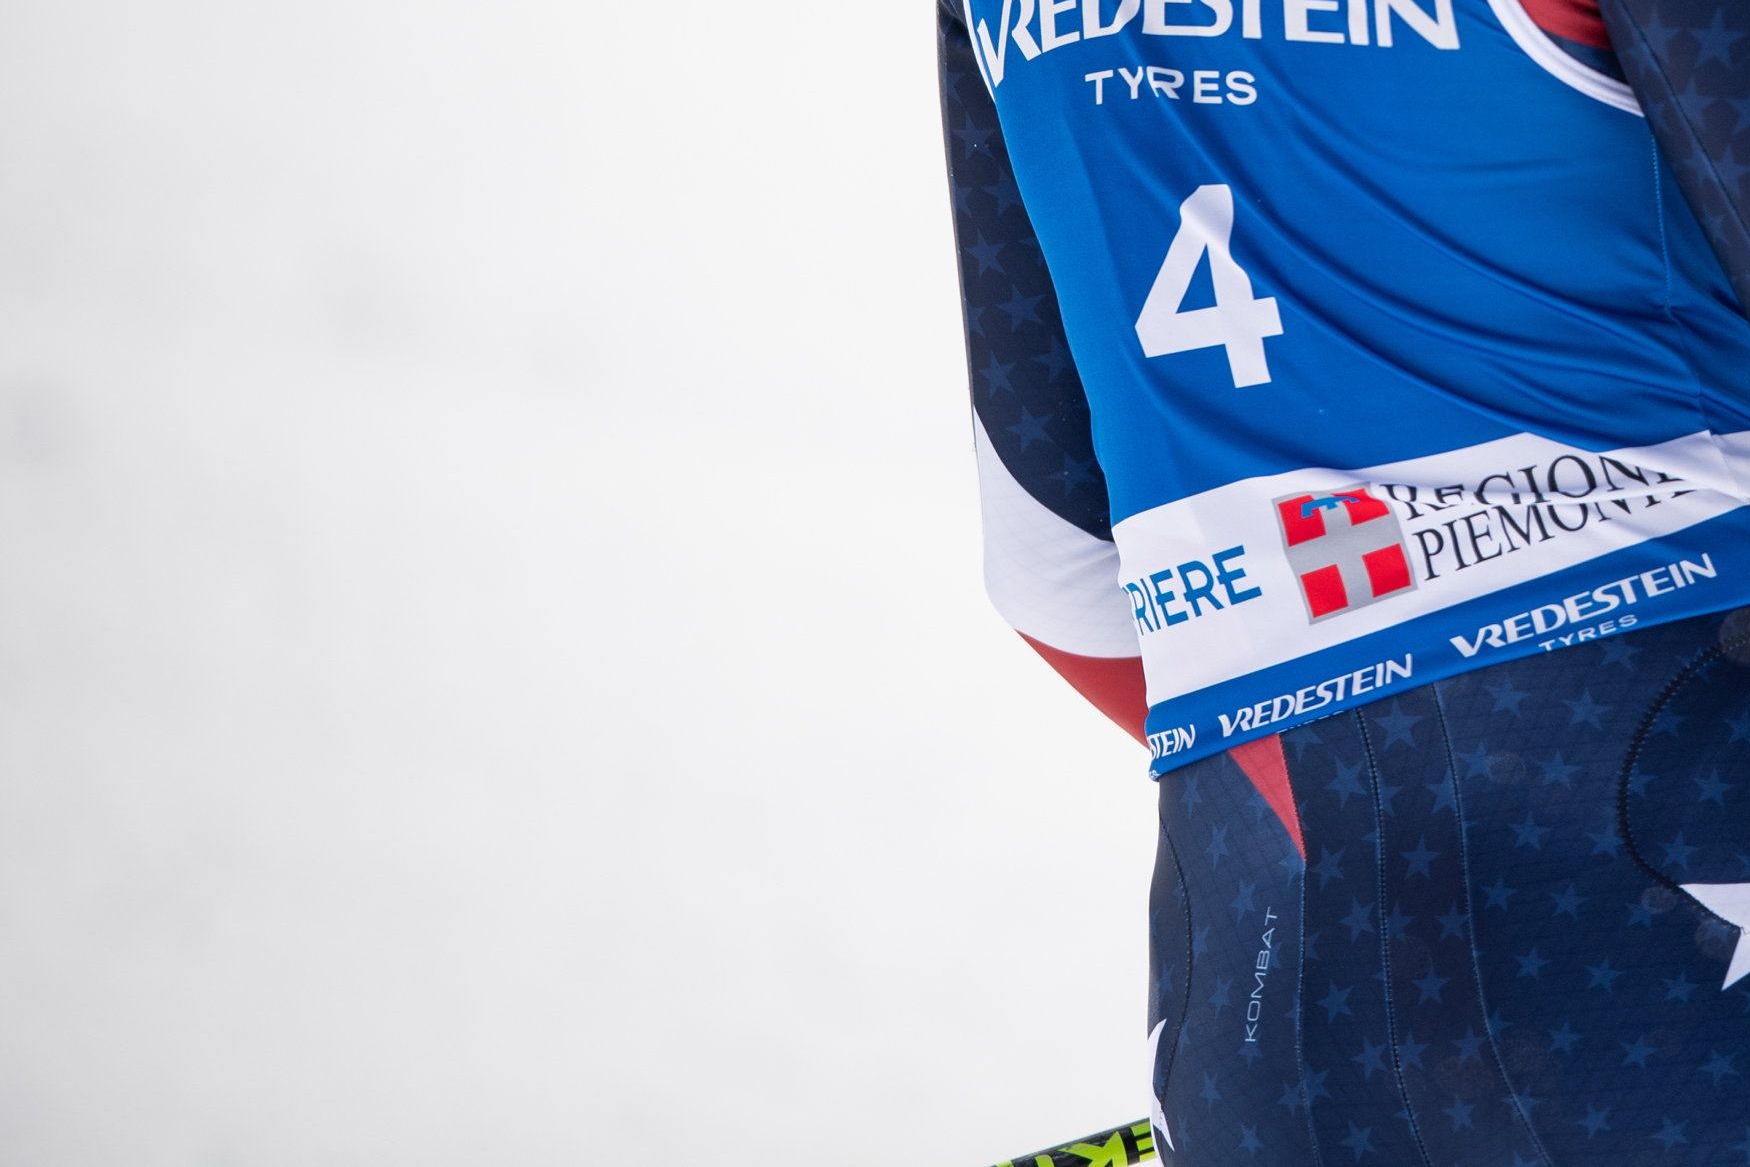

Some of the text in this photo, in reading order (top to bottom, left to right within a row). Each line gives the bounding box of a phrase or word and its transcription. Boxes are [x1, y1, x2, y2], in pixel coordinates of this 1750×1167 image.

[1085, 65, 1258, 106] TYRES
[1135, 183, 1284, 389] 4
[1122, 544, 1262, 636] RIERE
[1449, 552, 1718, 658] VREDESTEIN
[1538, 613, 1639, 652] TYRES
[1217, 652, 1412, 738] VREDESTEIN
[1244, 905, 1278, 1042] KOMBAT
